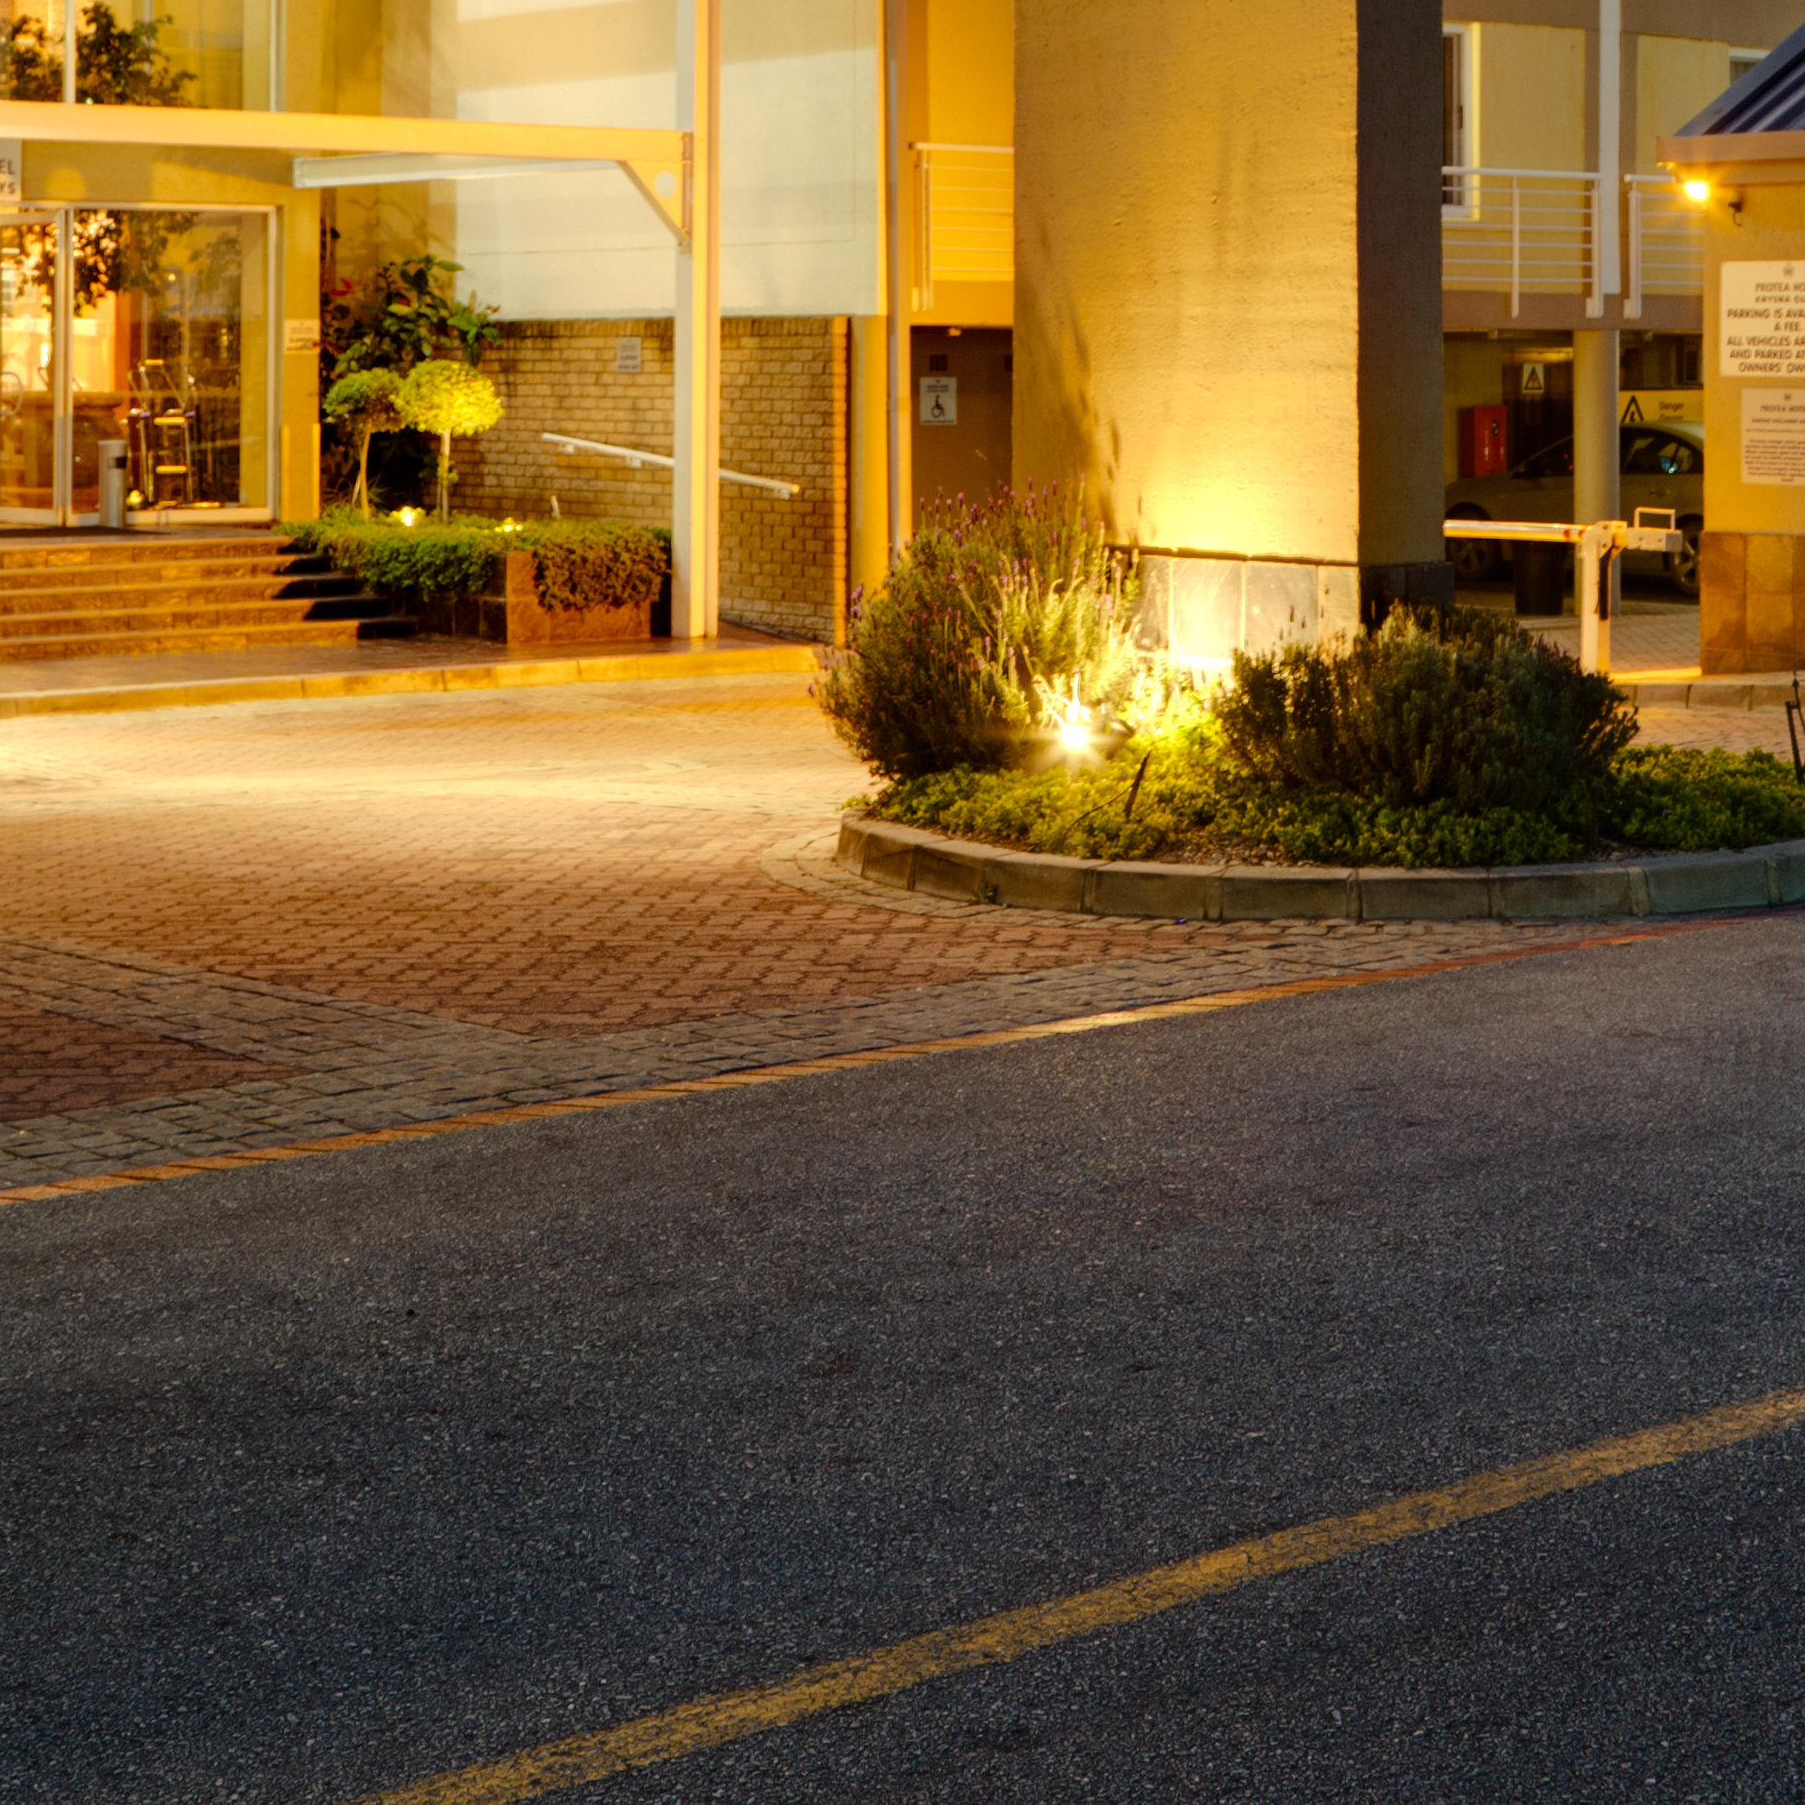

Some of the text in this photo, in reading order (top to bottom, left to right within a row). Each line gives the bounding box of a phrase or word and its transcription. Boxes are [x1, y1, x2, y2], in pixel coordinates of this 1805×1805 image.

[1755, 282, 1790, 292] PROTEA
[1727, 308, 1771, 318] PARKING
[1773, 308, 1783, 318] IS
[1774, 322, 1803, 332] A FEE.
[1727, 336, 1743, 346] ALL
[1746, 336, 1790, 347] VEHICLES
[1730, 349, 1752, 359] AND
[1754, 349, 1792, 359] PARKED
